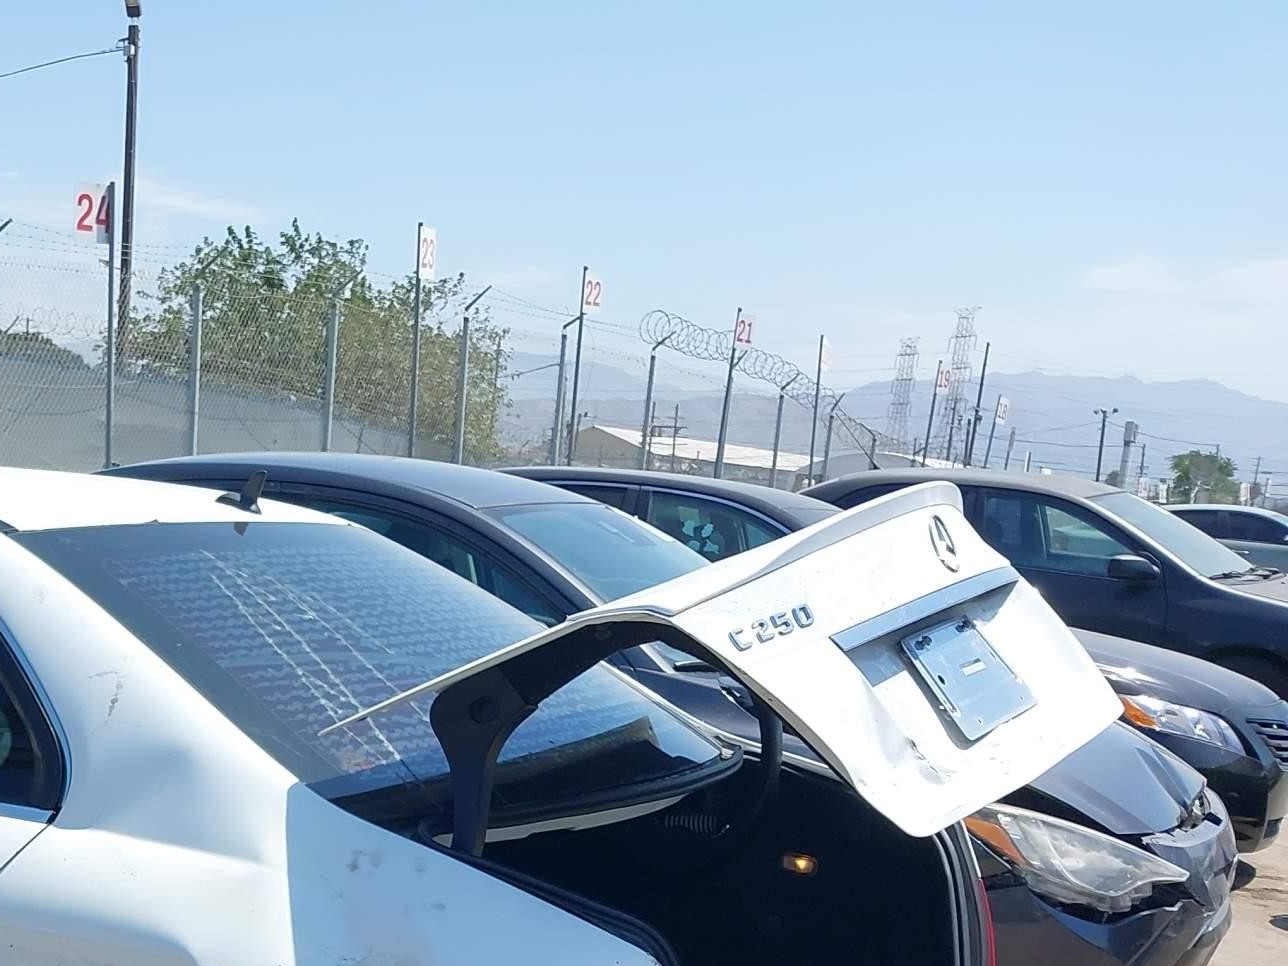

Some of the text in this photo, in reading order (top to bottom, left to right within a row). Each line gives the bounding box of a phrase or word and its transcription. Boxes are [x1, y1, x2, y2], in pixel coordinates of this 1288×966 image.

[76, 193, 111, 234] 24
[421, 237, 435, 270] 23
[585, 280, 601, 307] 22
[737, 319, 753, 344] 21
